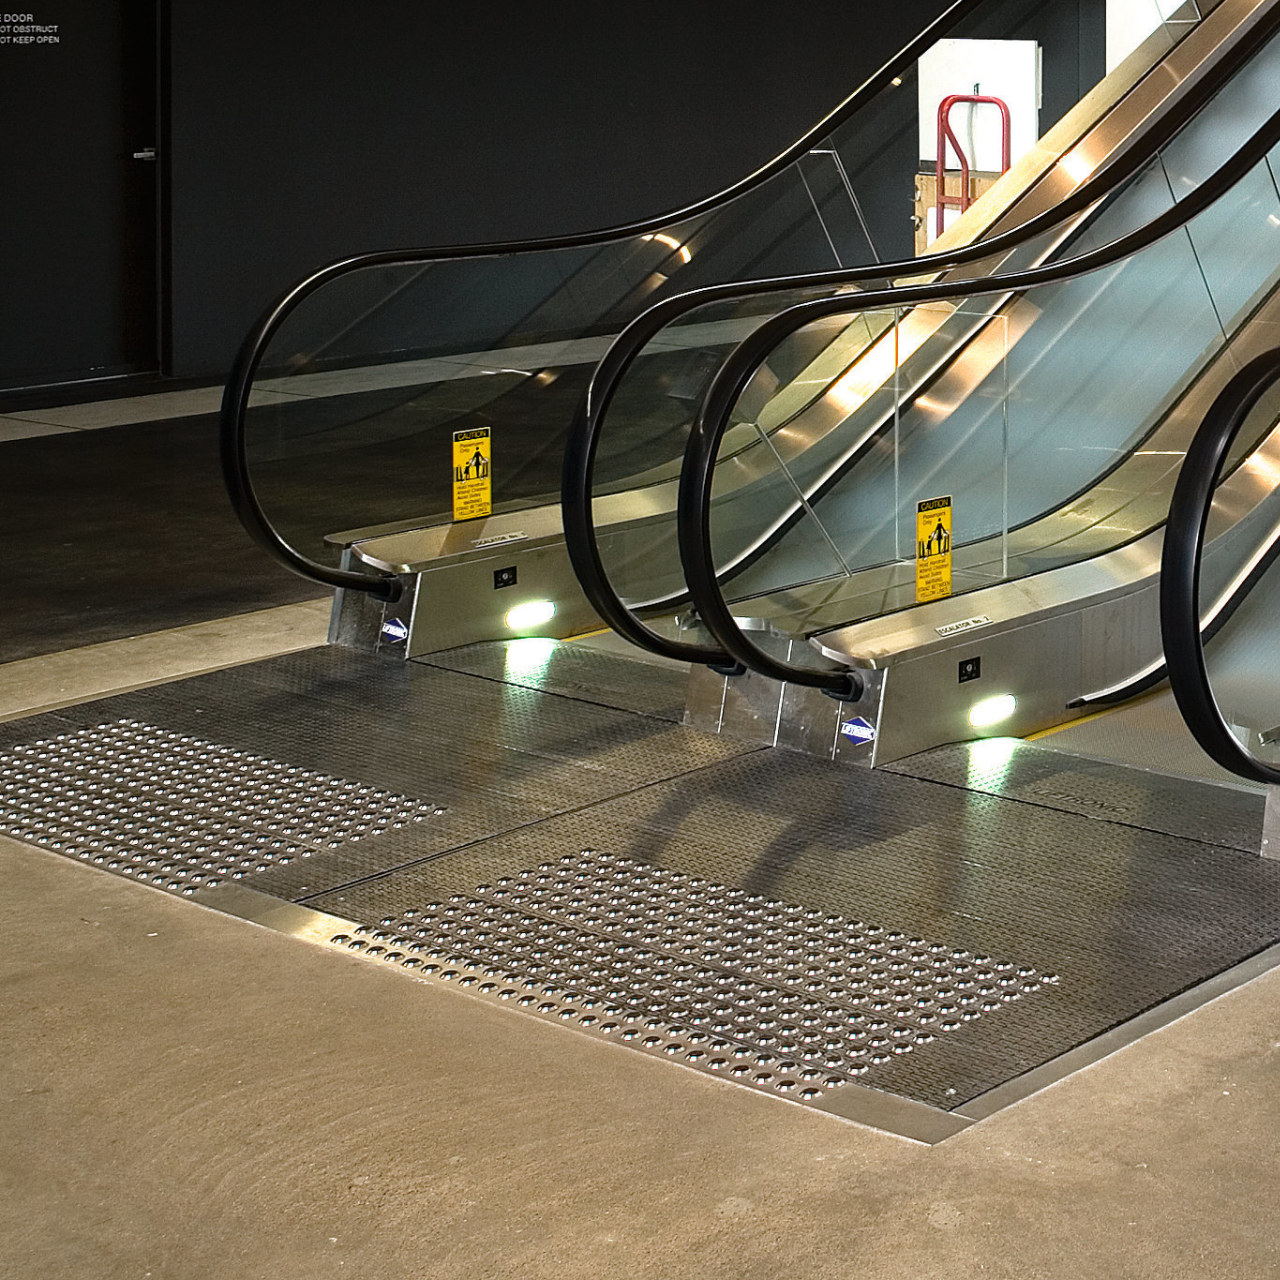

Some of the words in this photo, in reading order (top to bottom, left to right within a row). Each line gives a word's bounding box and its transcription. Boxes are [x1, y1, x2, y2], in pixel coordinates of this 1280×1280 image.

[4, 14, 34, 23] DOOR
[12, 25, 59, 33] OBSTRUCT
[13, 36, 35, 44] KEEP
[36, 35, 60, 44] OPEN
[457, 430, 487, 441] CAUTION
[920, 498, 949, 511] CAUTION
